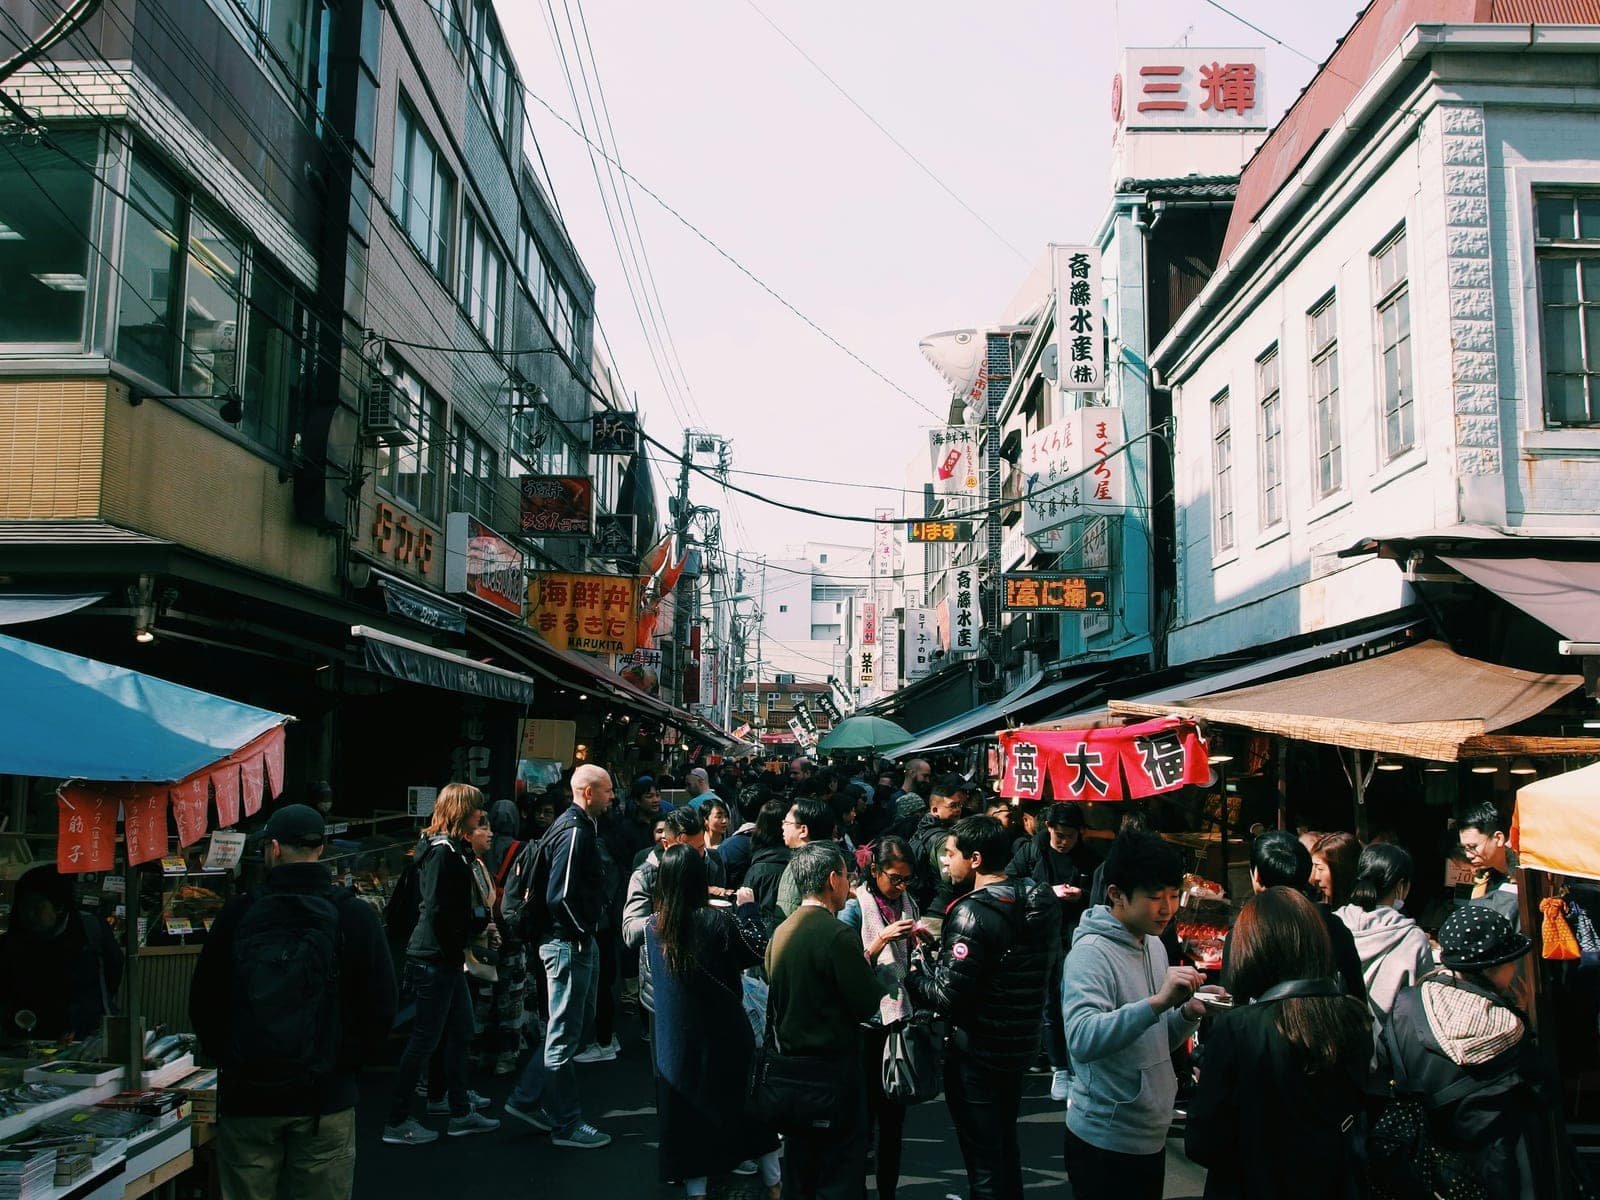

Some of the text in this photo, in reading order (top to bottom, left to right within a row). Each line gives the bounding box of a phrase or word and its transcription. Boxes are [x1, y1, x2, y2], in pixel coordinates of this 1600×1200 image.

[1137, 61, 1256, 115] 三輝
[933, 431, 971, 446] 海鮮丼
[1093, 422, 1112, 500] まぐろ屋
[541, 580, 630, 613] 海鮮丼
[538, 612, 627, 637] まるきた
[568, 637, 624, 651] MARUKITA
[861, 652, 873, 673] 茶
[1013, 728, 1185, 797] 苺大福
[67, 815, 85, 864] 筋子
